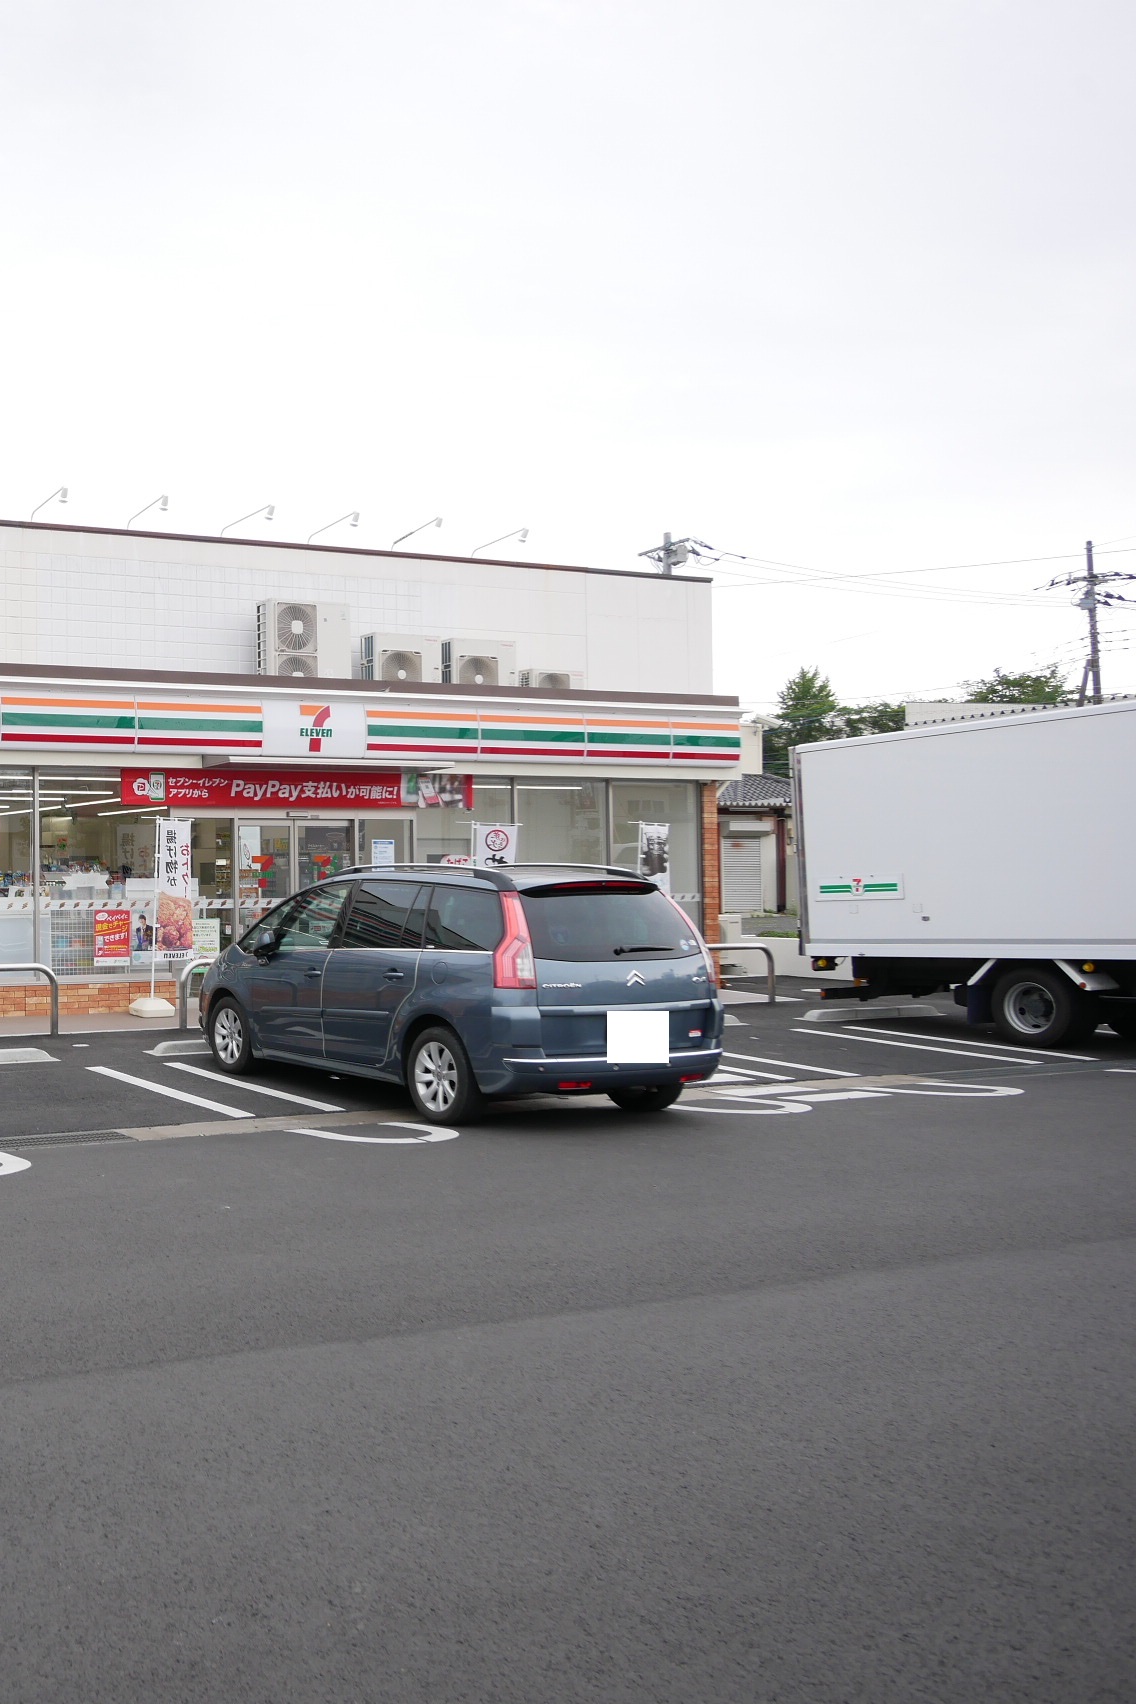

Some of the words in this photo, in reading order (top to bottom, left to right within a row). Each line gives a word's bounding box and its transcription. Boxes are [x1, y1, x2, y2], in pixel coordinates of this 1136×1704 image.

[299, 704, 331, 752] 7
[168, 788, 209, 799] アプリから
